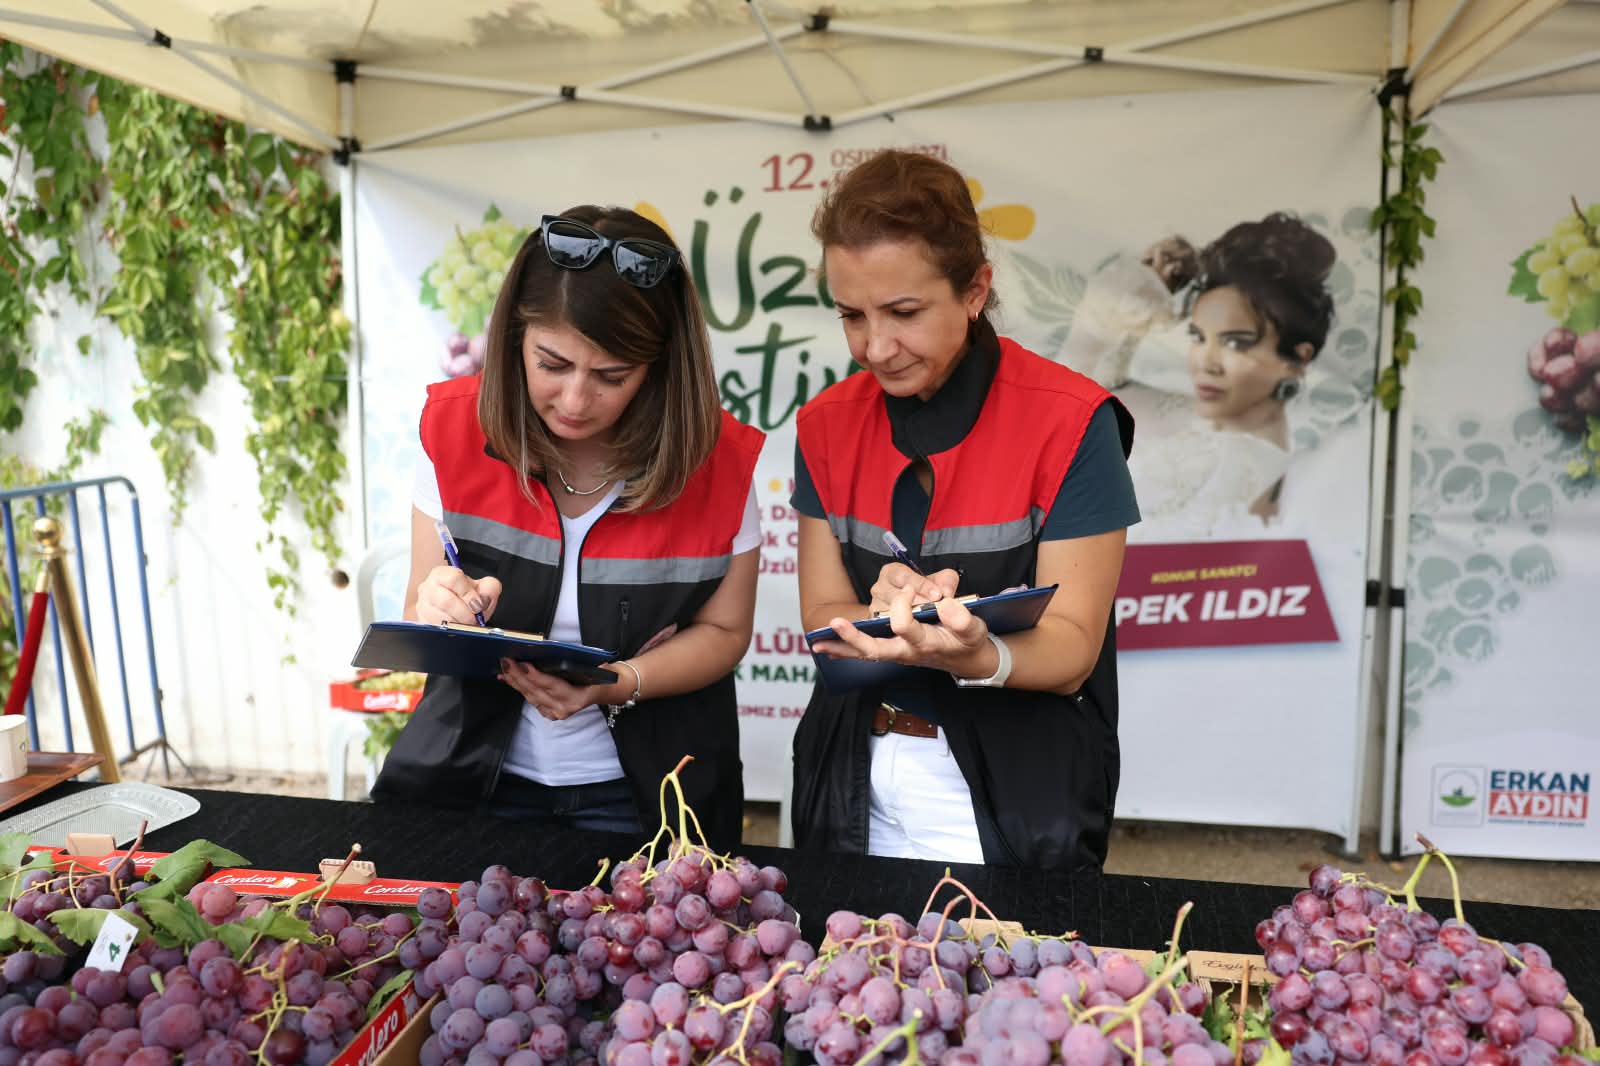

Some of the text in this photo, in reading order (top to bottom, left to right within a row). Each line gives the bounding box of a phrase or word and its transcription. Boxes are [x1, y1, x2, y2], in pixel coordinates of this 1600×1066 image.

[761, 151, 829, 192] 12.
[1200, 585, 1311, 621] ILDIZ
[1490, 770, 1590, 793] ERKAN
[1494, 794, 1584, 818] AYDIN
[213, 874, 276, 885] Cordero
